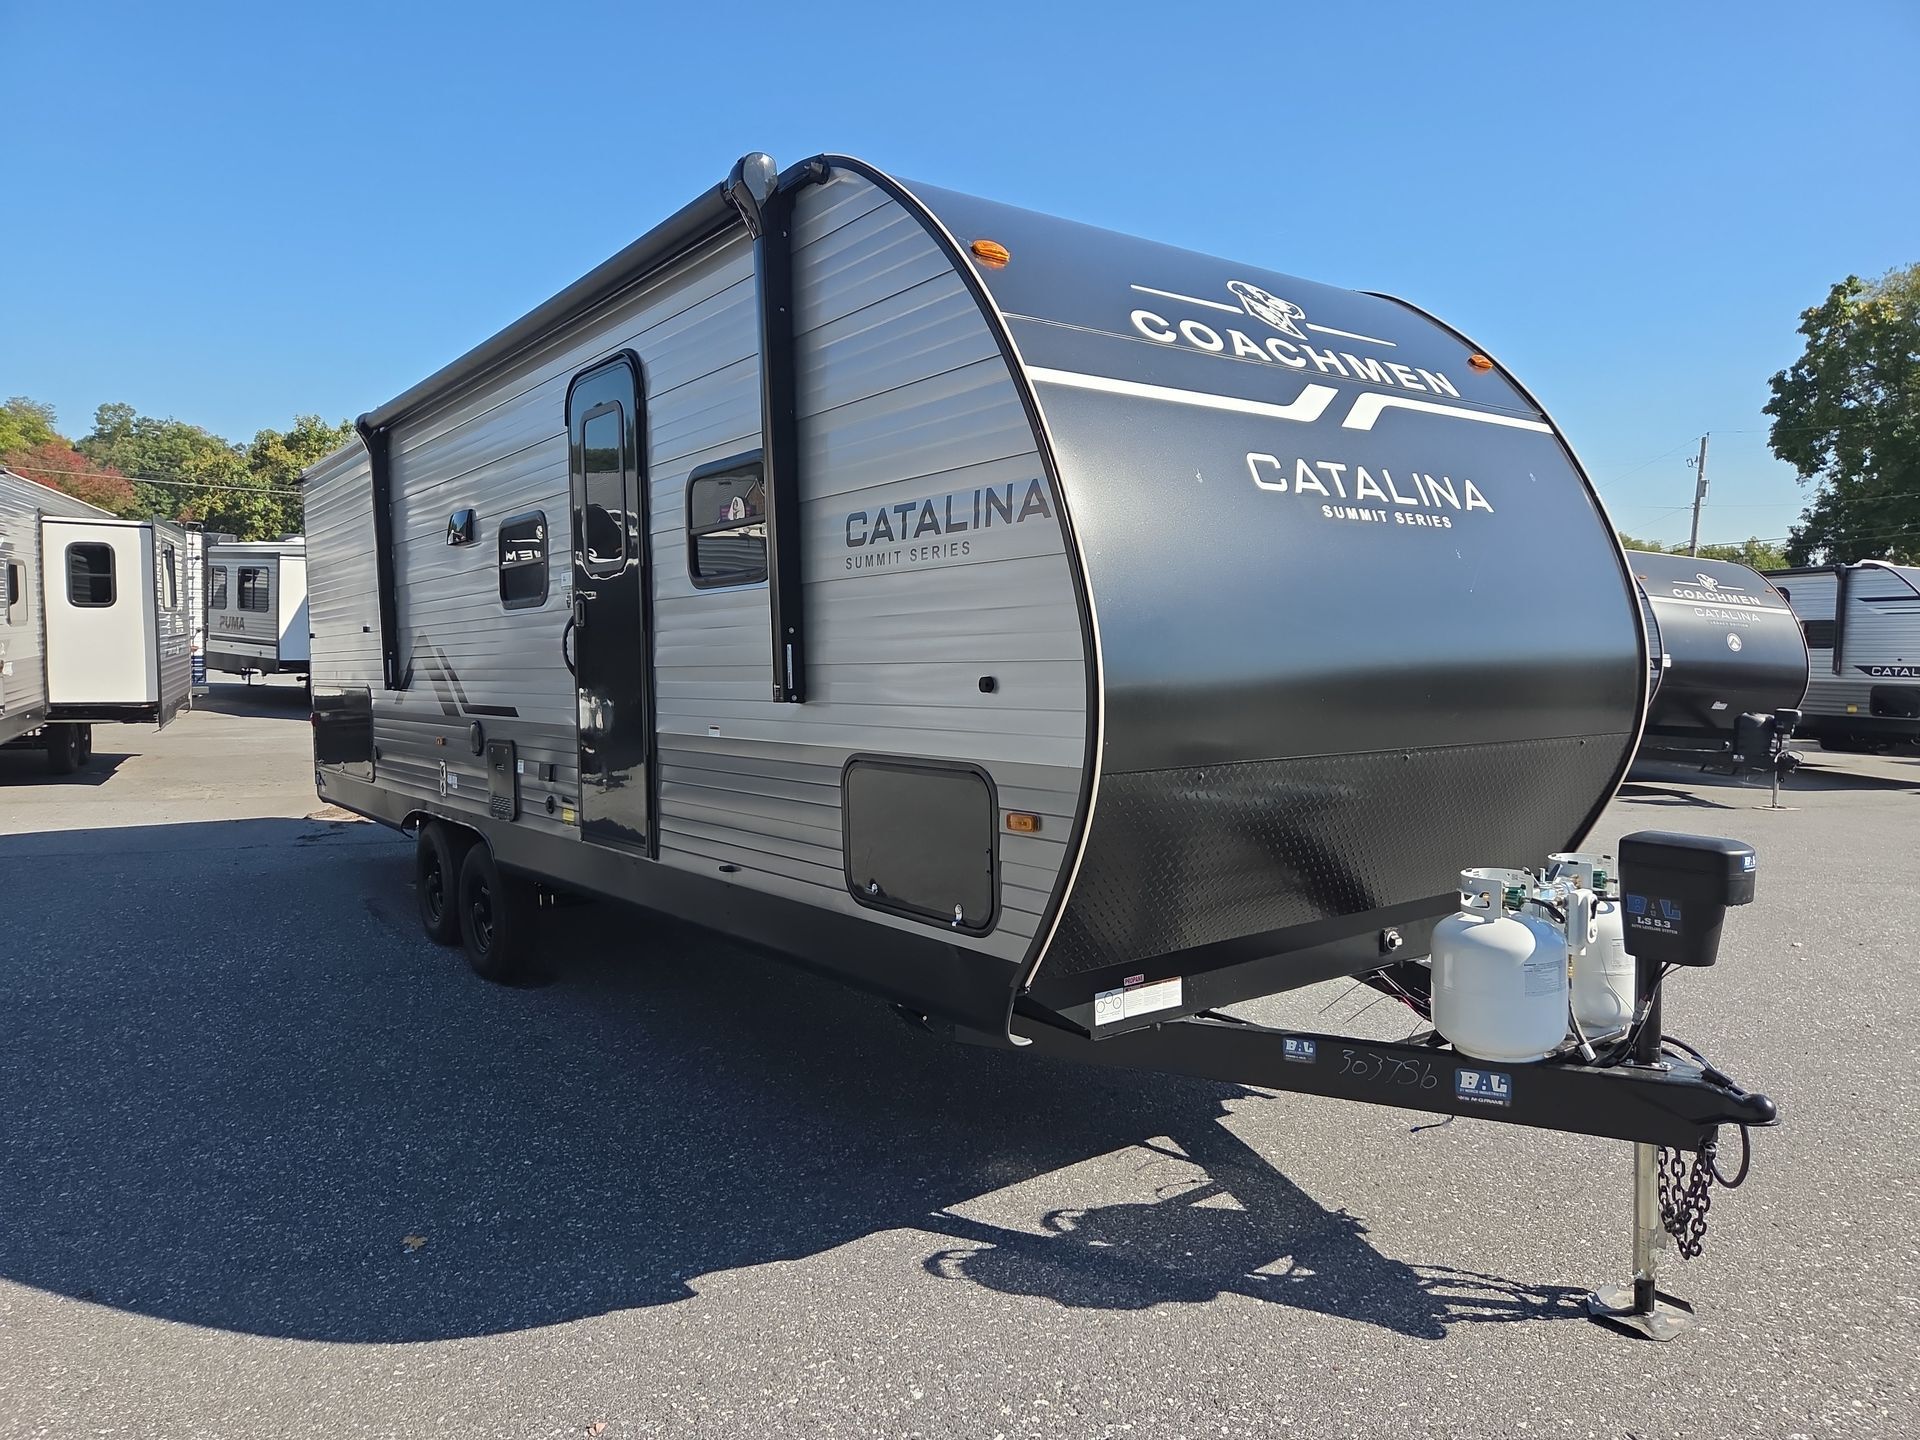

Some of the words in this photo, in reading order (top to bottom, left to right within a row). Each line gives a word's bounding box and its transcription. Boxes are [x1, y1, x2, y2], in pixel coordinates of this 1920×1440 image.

[1130, 308, 1460, 398] COACHMEN
[1246, 452, 1495, 513] CATALINA
[846, 478, 1052, 548] CATALINA
[1321, 504, 1388, 523] SUMMIT
[1395, 511, 1453, 529] SERIES
[845, 550, 902, 570] SUMMIT
[909, 540, 971, 562] SERIES
[1672, 588, 1761, 605] COACHMEN
[219, 615, 245, 630] PUMA
[1694, 608, 1761, 622] CATALINA
[1637, 916, 1652, 926] LS
[1124, 975, 1143, 985] PROPANE
